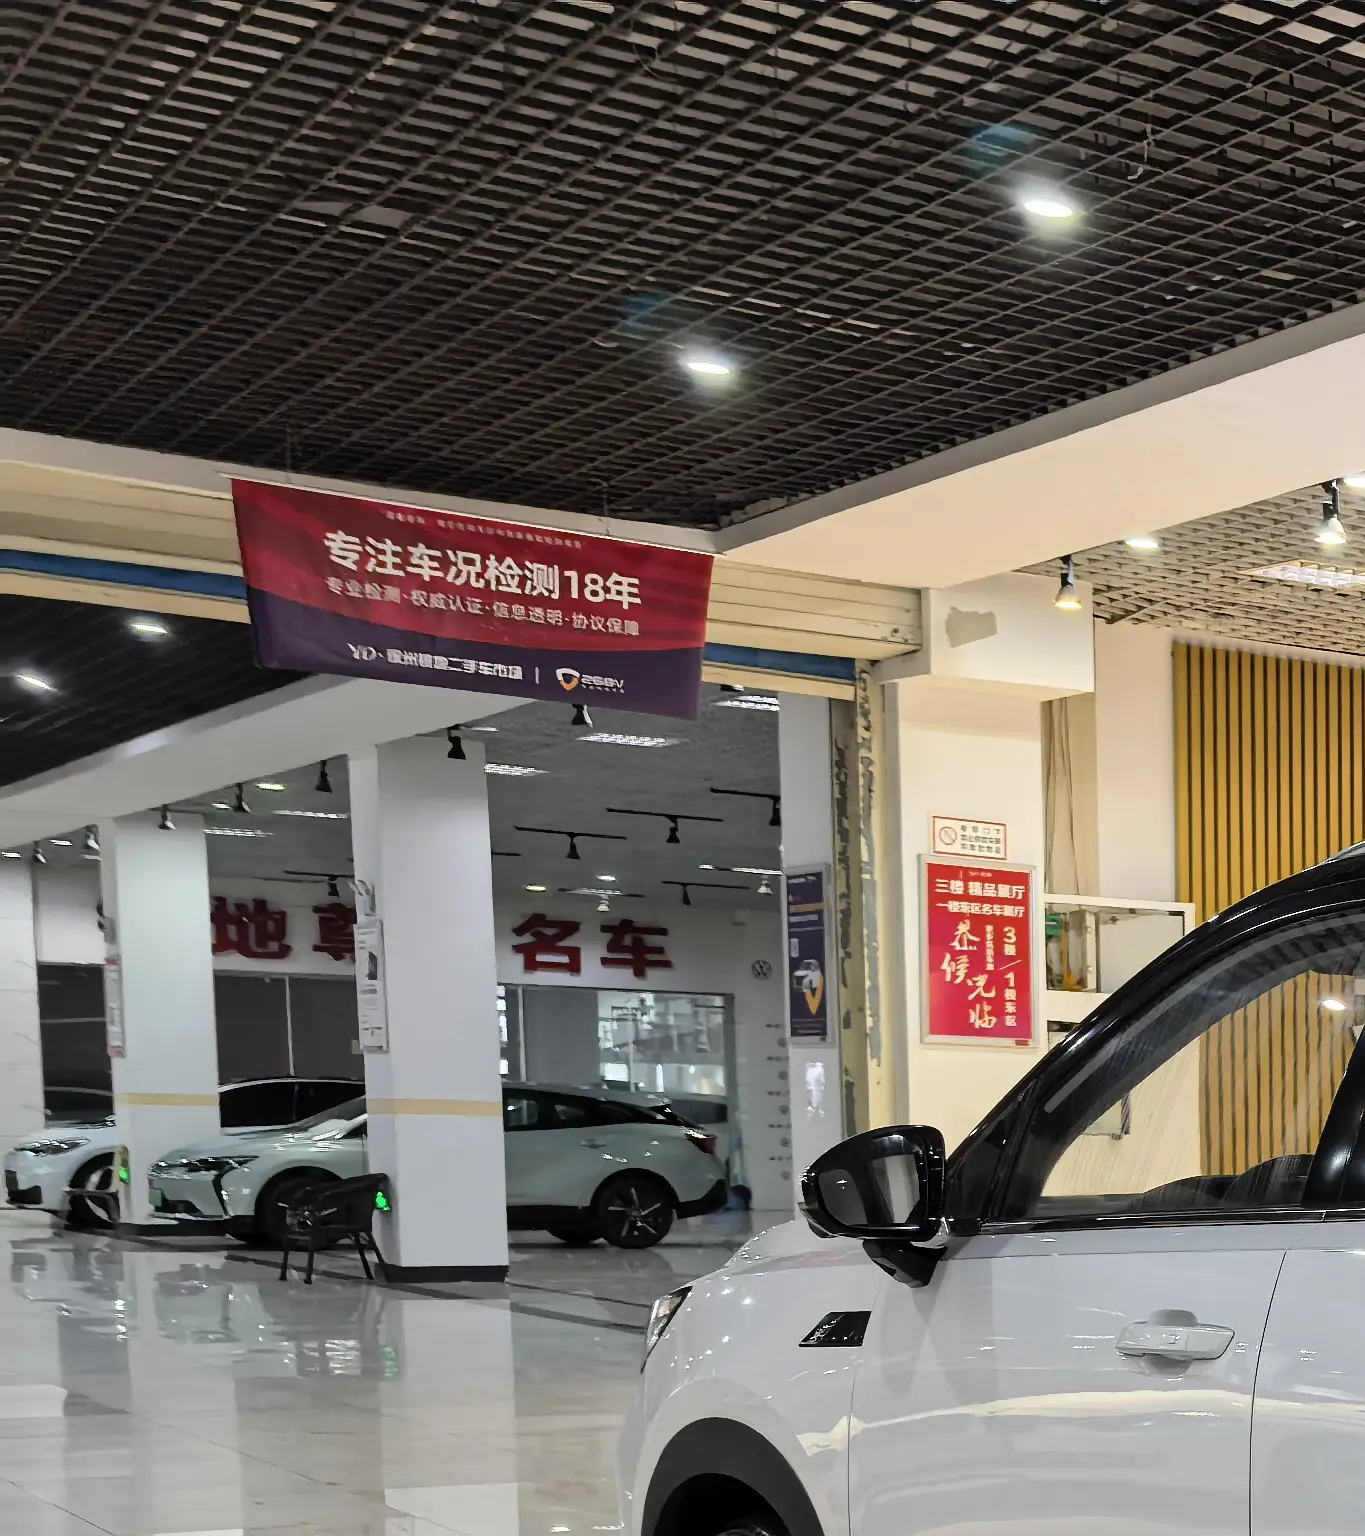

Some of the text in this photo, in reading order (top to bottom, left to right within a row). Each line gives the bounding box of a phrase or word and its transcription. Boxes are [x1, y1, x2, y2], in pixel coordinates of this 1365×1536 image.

[323, 529, 642, 610] 专注车况检测18年
[511, 913, 676, 980] 名车
